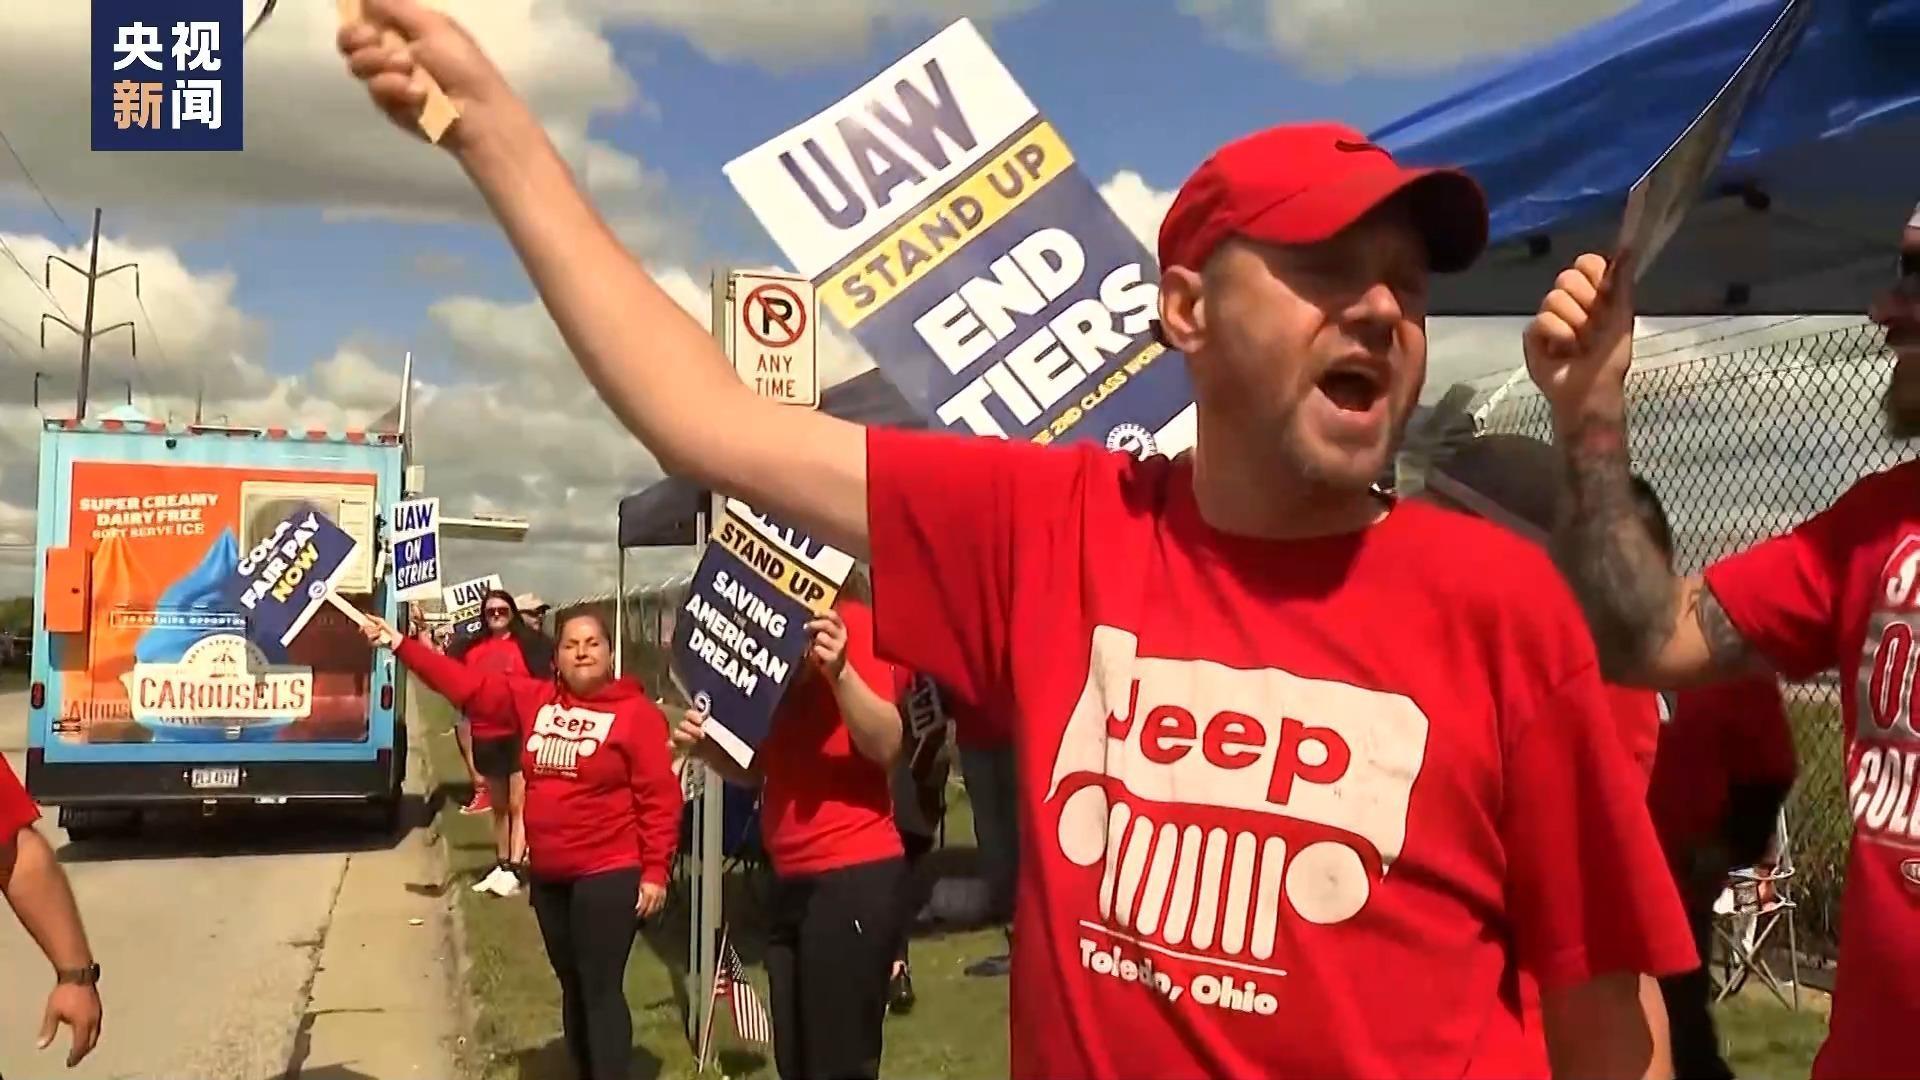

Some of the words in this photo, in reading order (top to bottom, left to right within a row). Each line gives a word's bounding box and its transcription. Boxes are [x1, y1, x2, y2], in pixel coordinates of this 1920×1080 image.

[778, 57, 978, 230] UAW
[841, 195, 984, 309] STAND
[986, 143, 1046, 200] UP
[913, 227, 1087, 375] END
[757, 353, 793, 373] ANY
[936, 263, 1160, 440] TIERS
[755, 377, 796, 398] TIME
[80, 497, 140, 511] SUPER
[142, 493, 218, 507] CREAMY
[97, 510, 155, 527] DAIRY
[156, 508, 202, 523] FREE
[175, 523, 205, 536] ICE
[395, 503, 433, 531] UAW
[240, 556, 289, 610] FAIR
[281, 511, 320, 560] PAY
[271, 542, 320, 604] NOW
[397, 557, 436, 588] STRIKE
[404, 538, 422, 562] ON
[720, 522, 785, 580] STAND
[789, 571, 825, 605] UP
[453, 579, 490, 606] UAW
[712, 570, 788, 640] SAVING
[684, 593, 790, 685] AMERICAN
[688, 627, 759, 697] DREAM
[140, 677, 305, 711] CAROUSEL'S
[545, 707, 597, 736] eep
[1106, 679, 1351, 806] Jeep
[1079, 938, 1184, 1003] Toledo,
[1190, 974, 1278, 1016] Ohio
